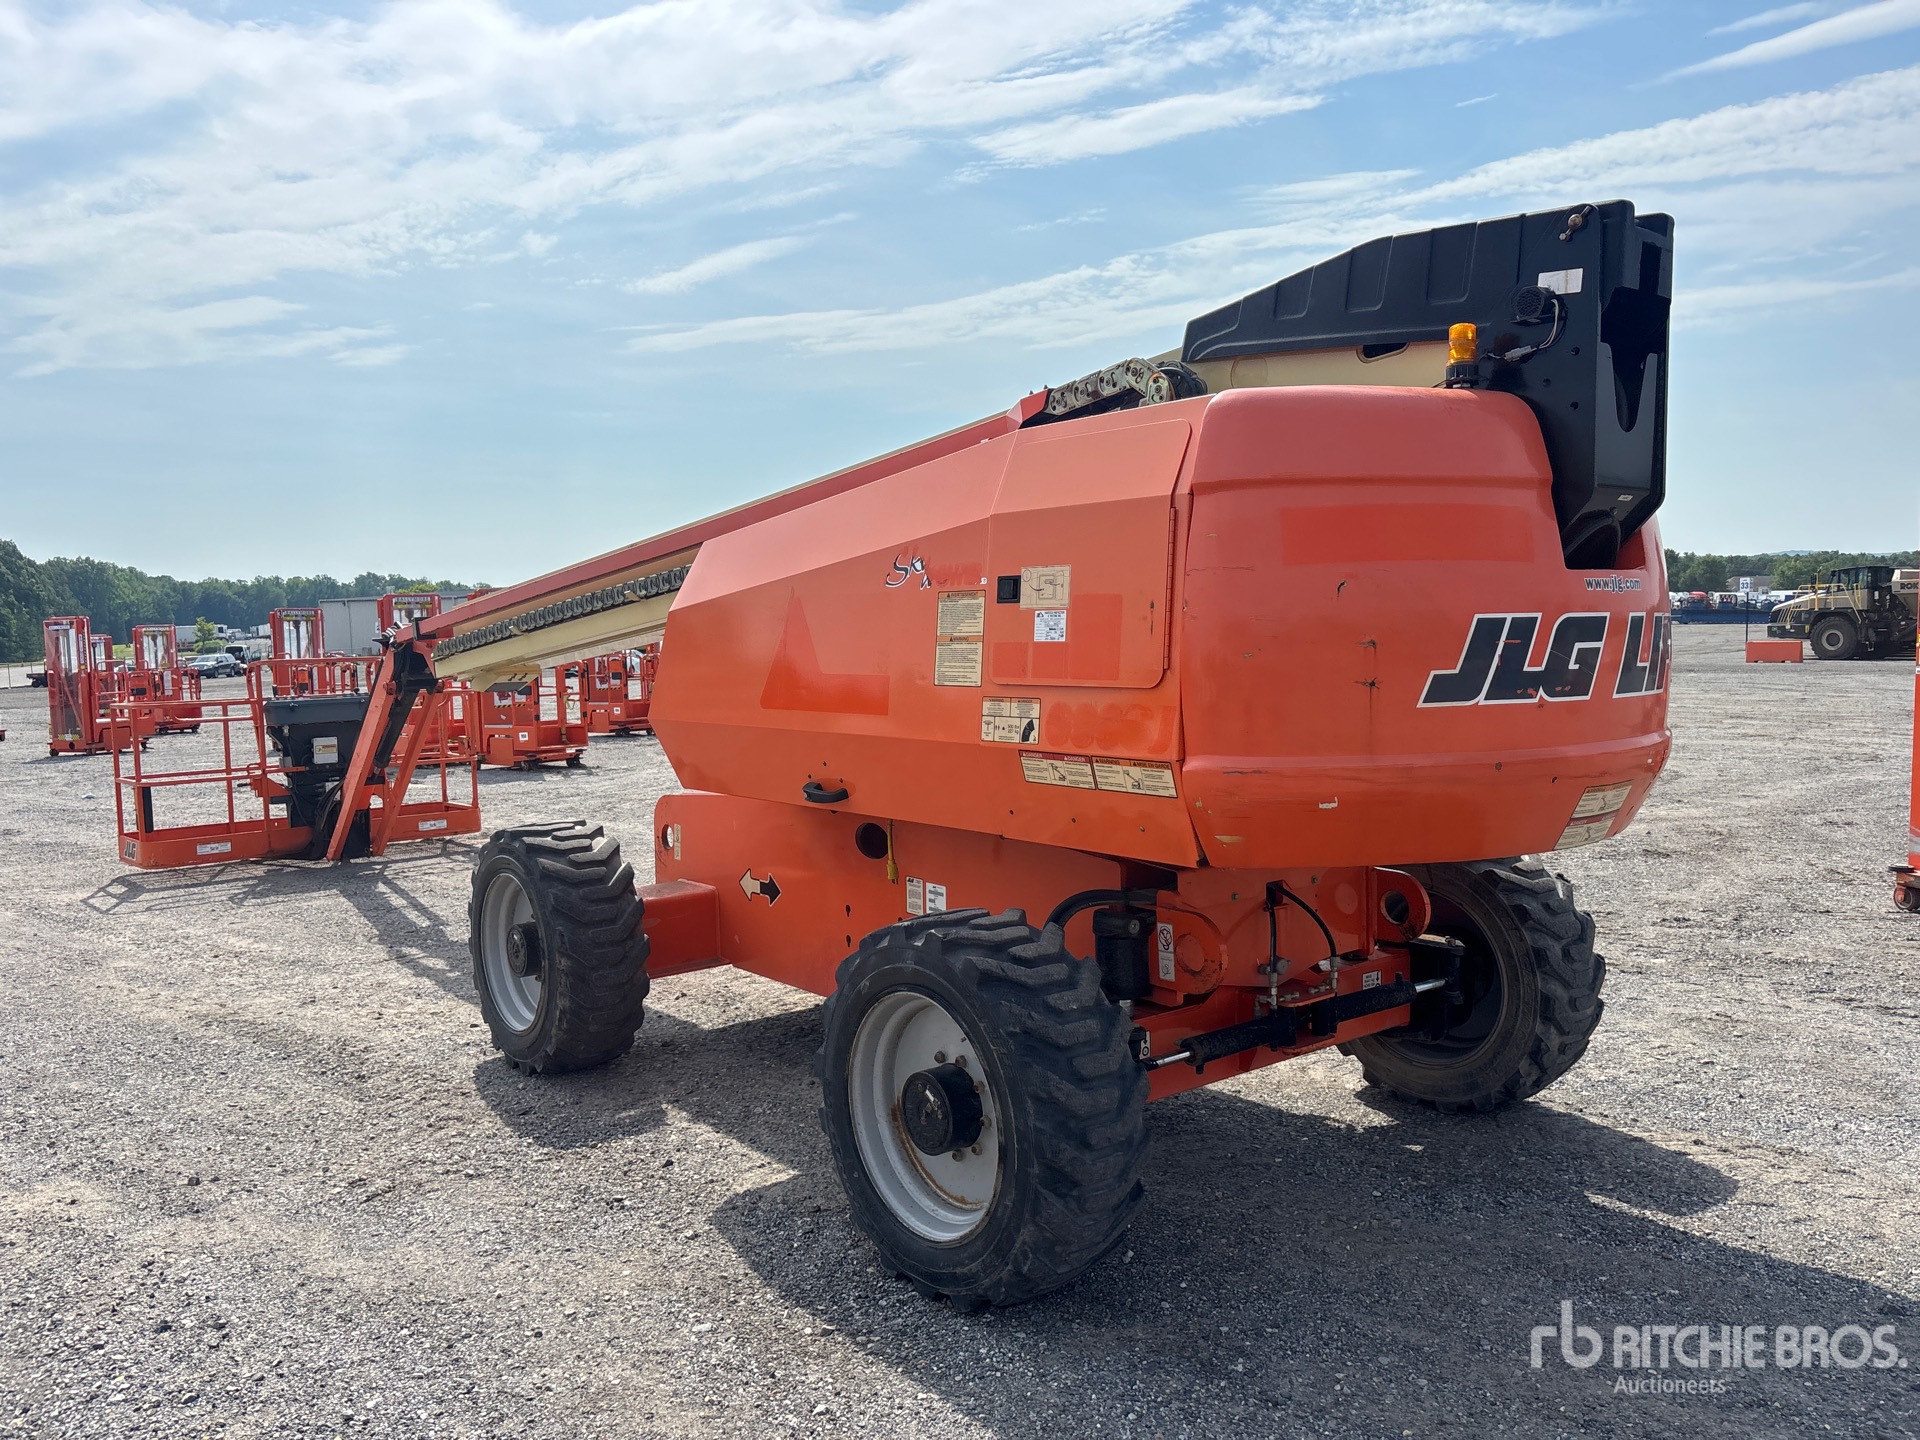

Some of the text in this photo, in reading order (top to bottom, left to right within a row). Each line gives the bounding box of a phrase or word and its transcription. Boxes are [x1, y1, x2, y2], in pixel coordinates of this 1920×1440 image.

[1584, 575, 1641, 593] www.jlg.com
[1740, 581, 1749, 590] 33
[1416, 612, 1610, 708] JLG
[124, 840, 137, 860] JLG
